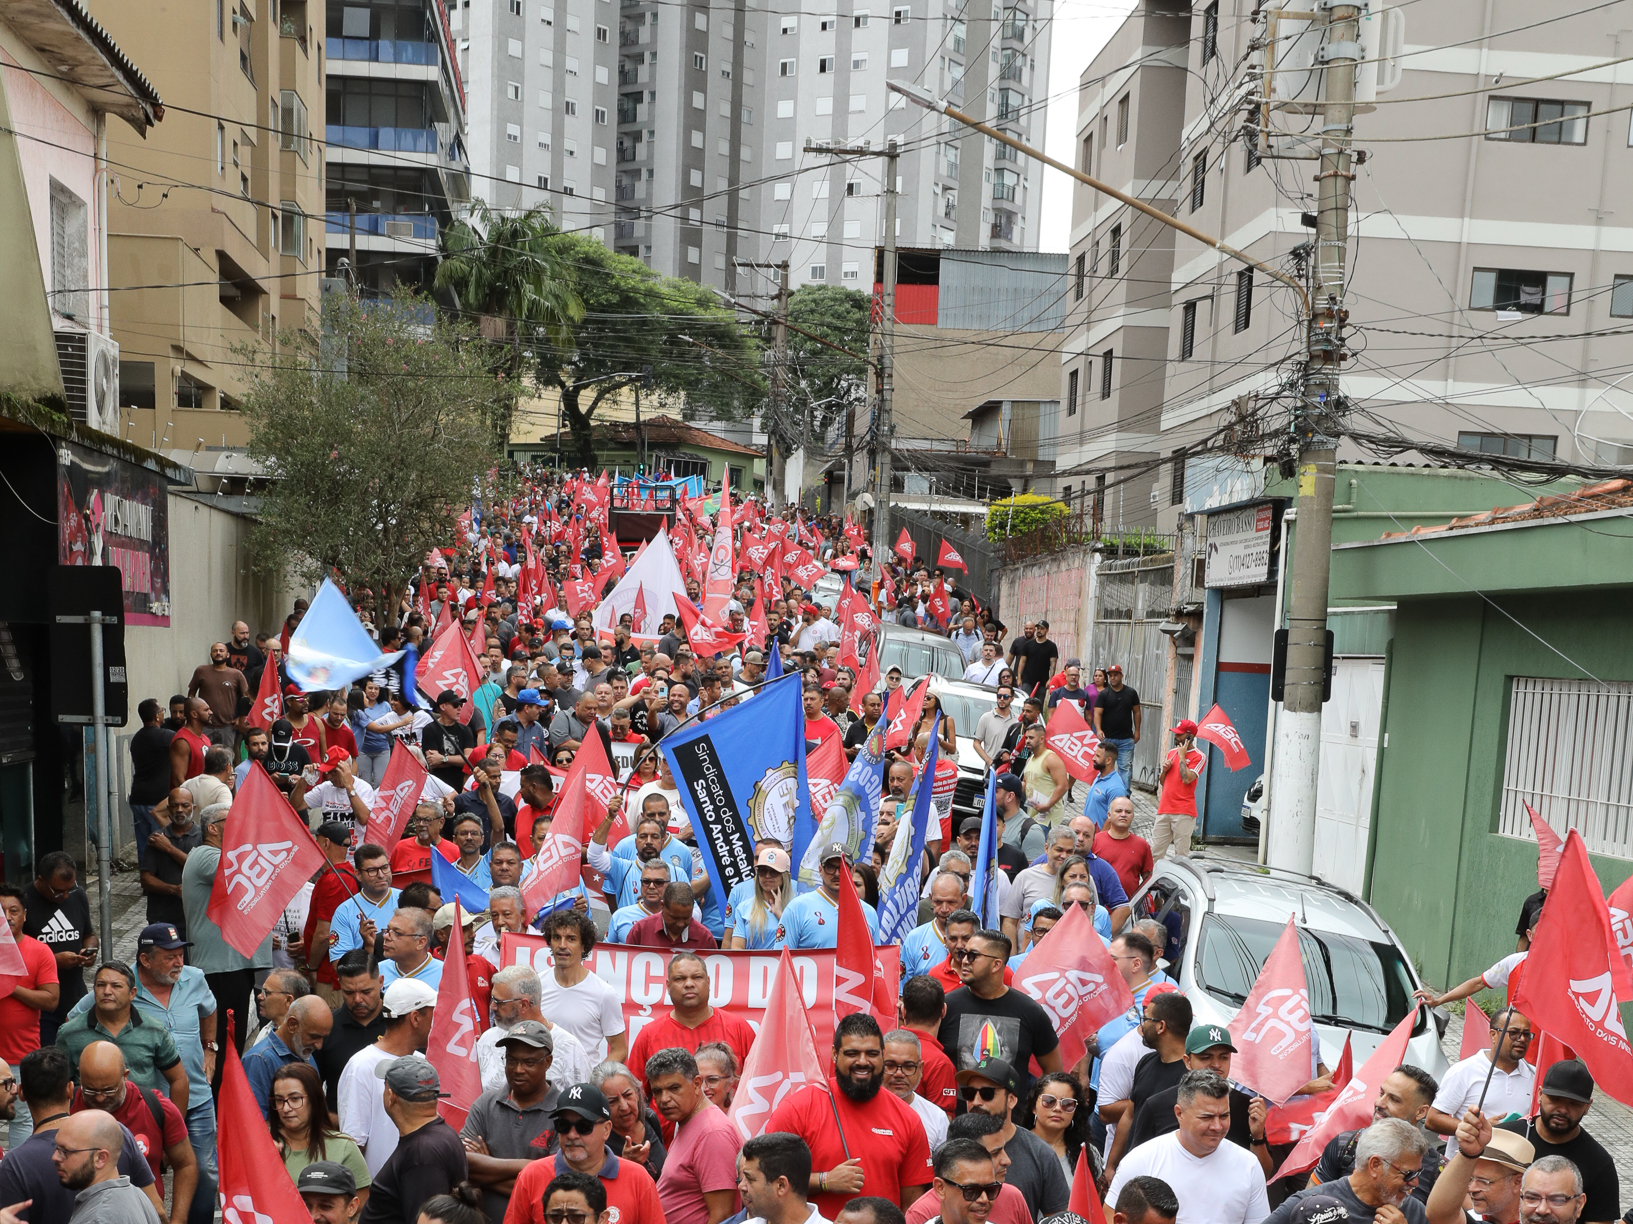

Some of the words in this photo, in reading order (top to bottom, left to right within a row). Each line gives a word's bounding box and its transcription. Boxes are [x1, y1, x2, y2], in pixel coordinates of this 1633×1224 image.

[104, 492, 154, 542] RESTAURANTE
[1209, 517, 1236, 539] CHAVEIRO
[1236, 513, 1256, 535] BASSO
[266, 760, 299, 772] BOSS
[1048, 732, 1096, 768] ABC
[694, 742, 726, 806] Sindicato
[719, 806, 737, 835] dos
[693, 778, 716, 822] Santo
[709, 823, 735, 867] André
[37, 929, 80, 944] adidas
